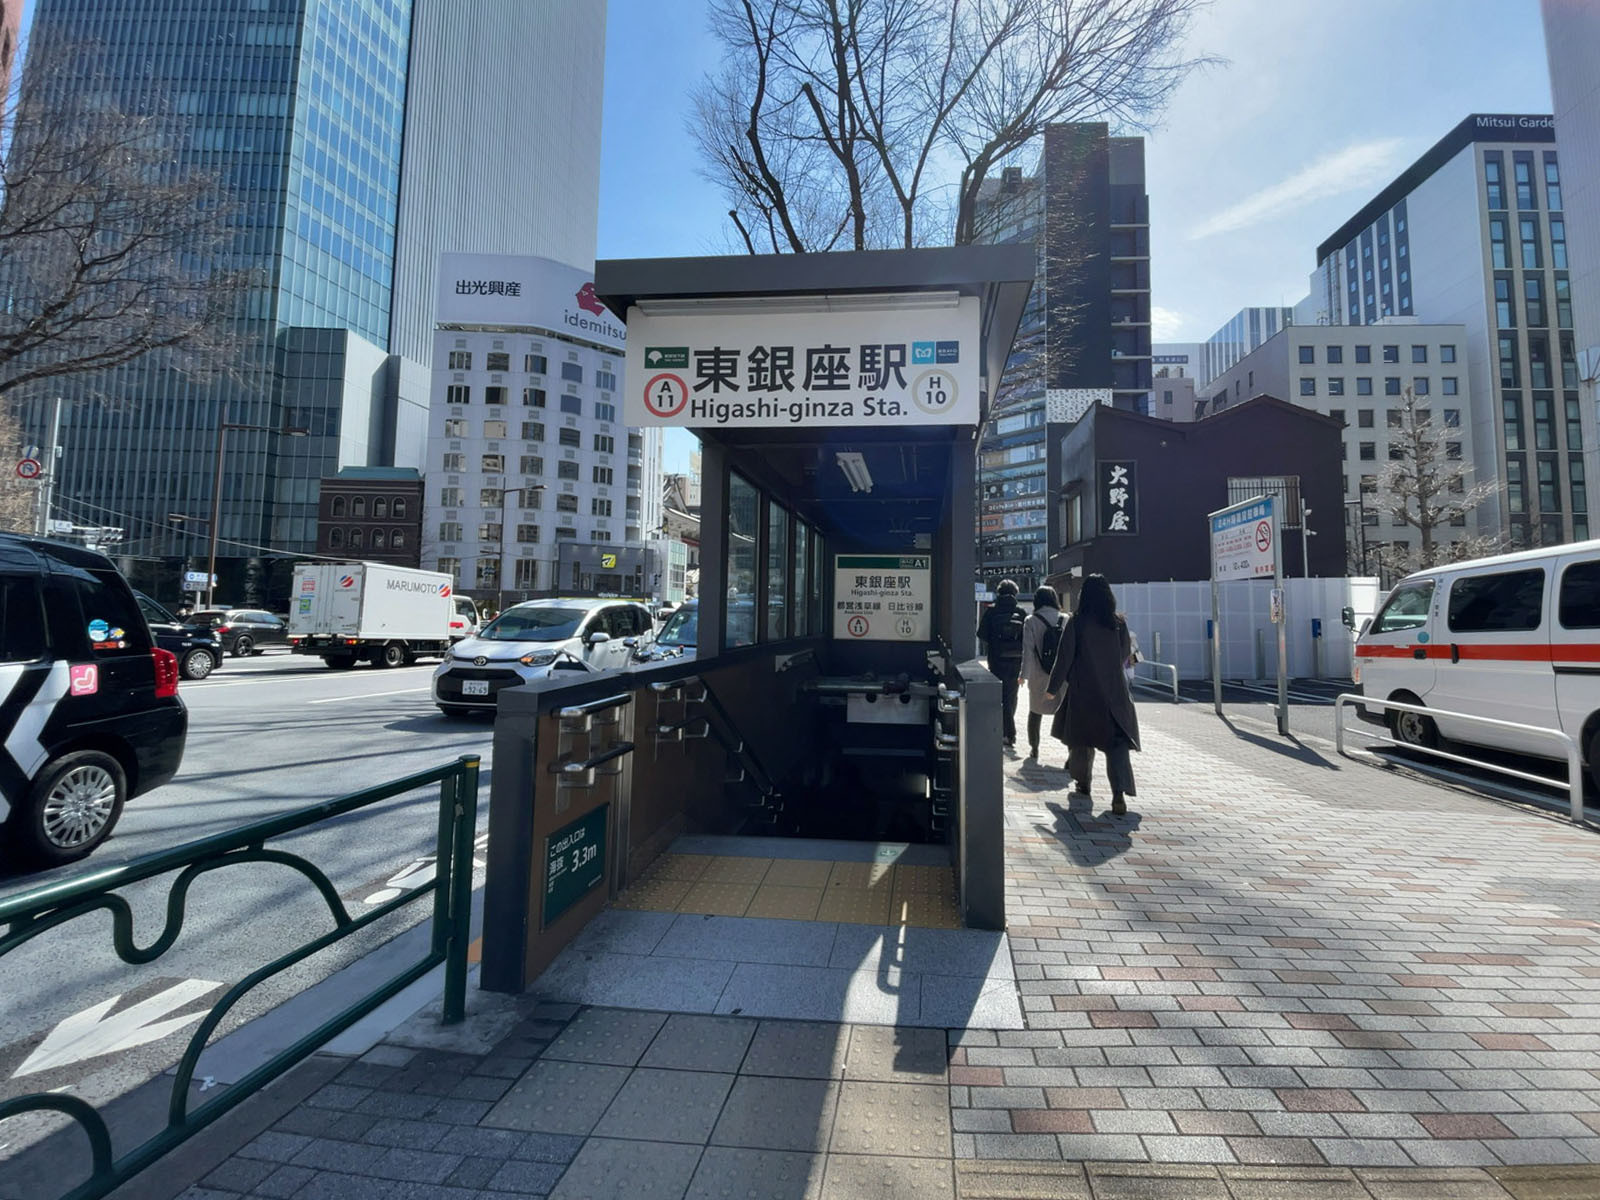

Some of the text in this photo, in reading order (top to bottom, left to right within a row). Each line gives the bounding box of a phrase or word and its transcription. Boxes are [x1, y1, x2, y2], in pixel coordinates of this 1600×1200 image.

[1476, 117, 1516, 128] Mitsui
[455, 279, 521, 297] 出光興産
[564, 309, 627, 341] idemitsu
[693, 343, 908, 394] 東銀座駅
[660, 381, 672, 393] A
[930, 377, 941, 389] H
[657, 395, 675, 409] 11
[925, 390, 947, 405] 10
[690, 396, 909, 423] Higashi-ginza Sta.
[1108, 464, 1130, 531] 大野屋
[914, 559, 927, 568] A1
[386, 579, 438, 595] MARUMOTO
[855, 575, 911, 589] 東銀座駅
[851, 589, 899, 598] Higashi-ginza
[888, 602, 924, 611] 日比谷線
[571, 843, 597, 873] 3.3m
